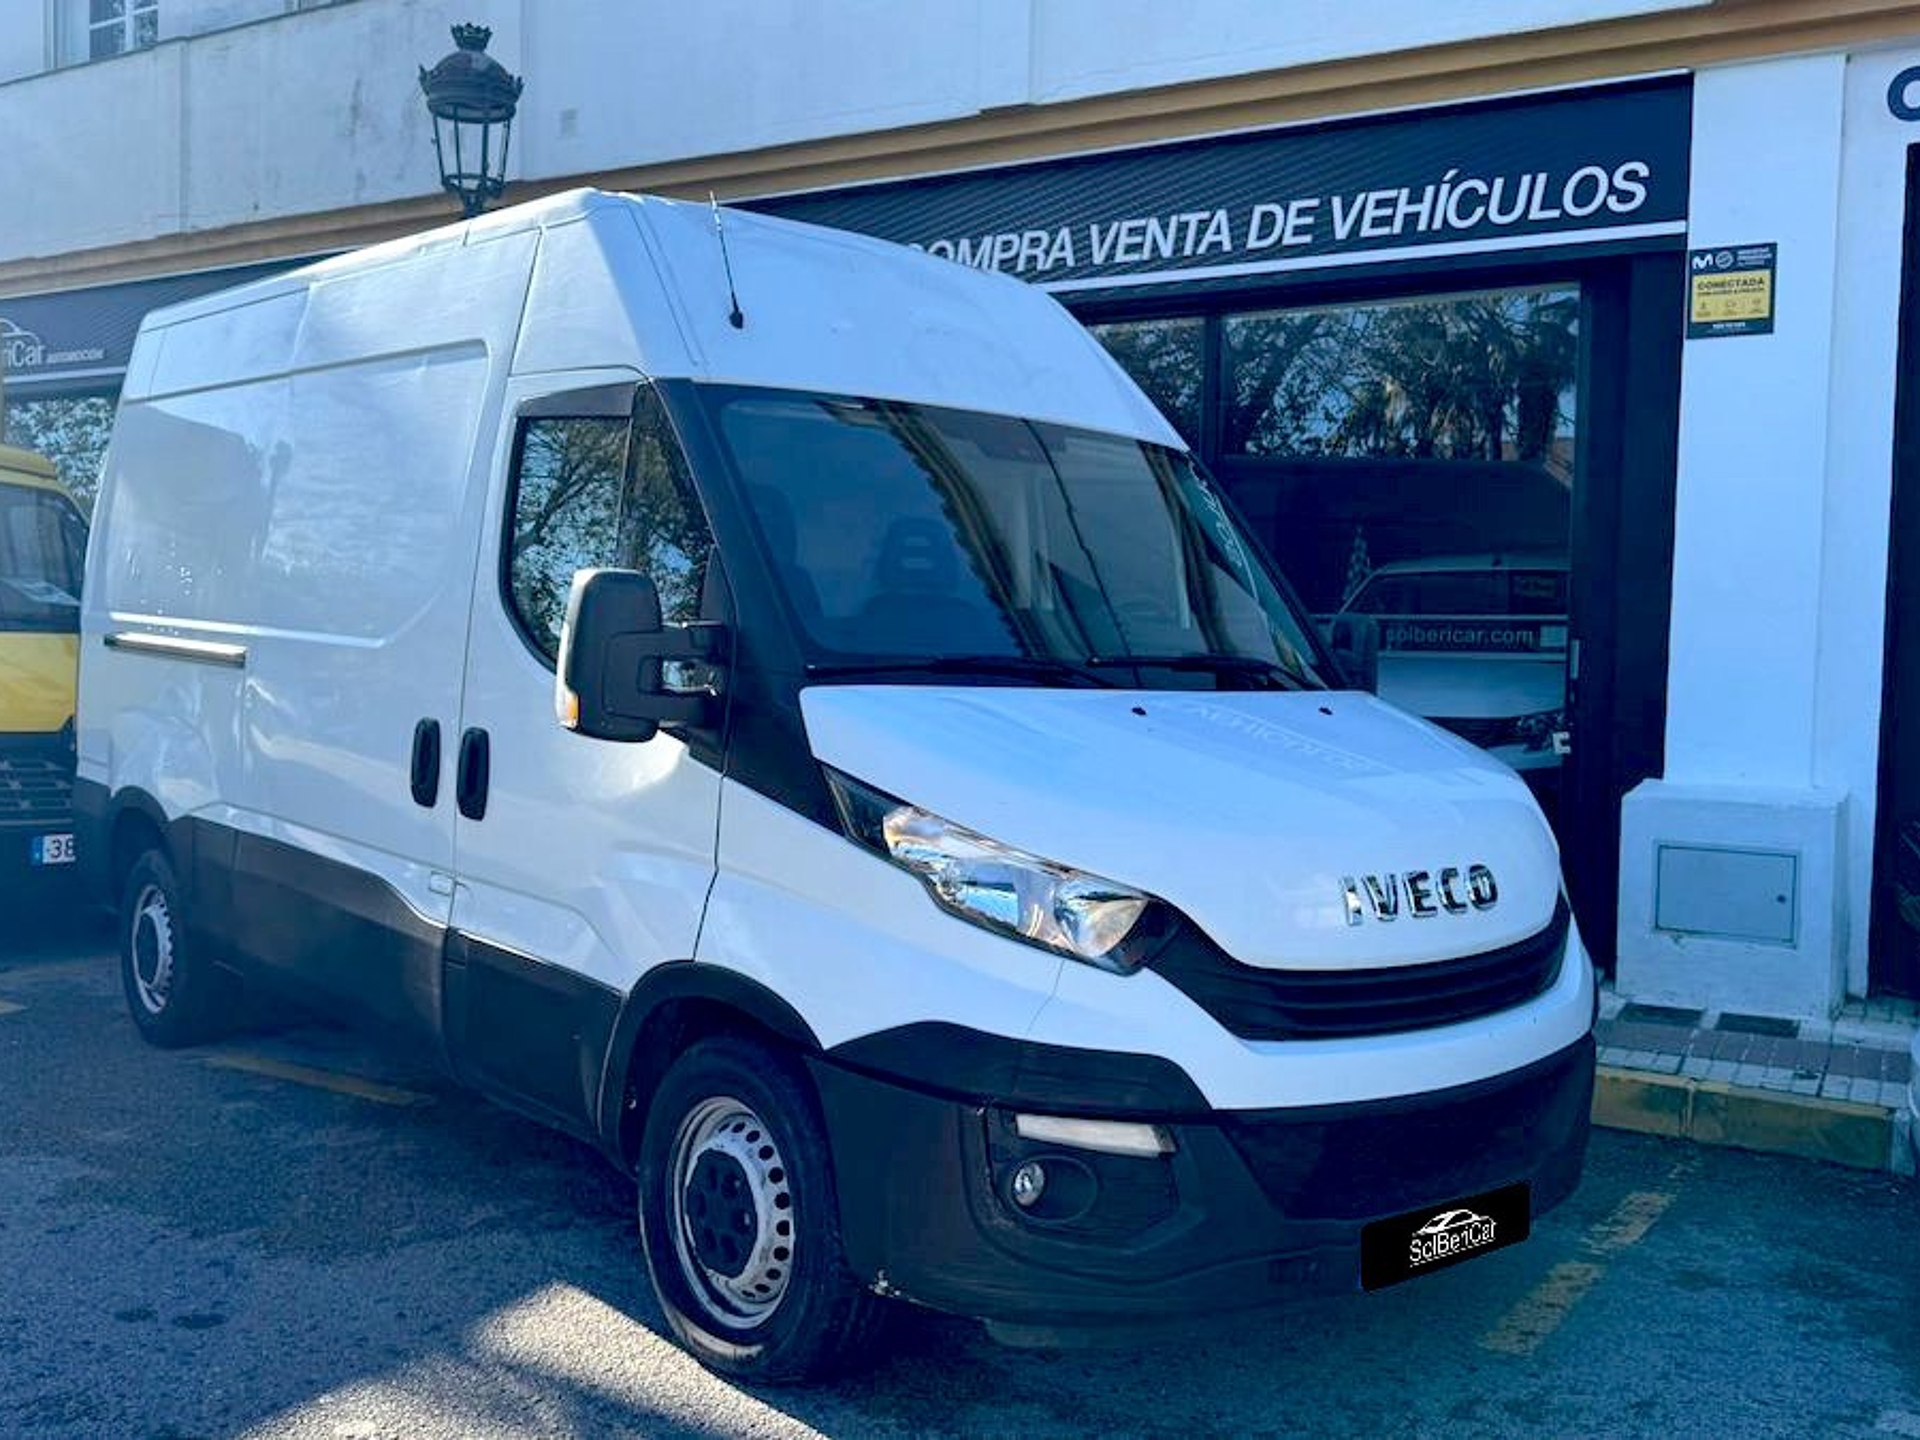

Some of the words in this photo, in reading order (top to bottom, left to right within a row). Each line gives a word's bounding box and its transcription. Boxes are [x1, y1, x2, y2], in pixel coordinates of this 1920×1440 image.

[908, 226, 1076, 272] MPRA
[1090, 209, 1232, 265] VENTA
[1246, 198, 1320, 249] DE
[1331, 161, 1650, 240] VEHÍCULOS
[1341, 864, 1498, 926] IVECO
